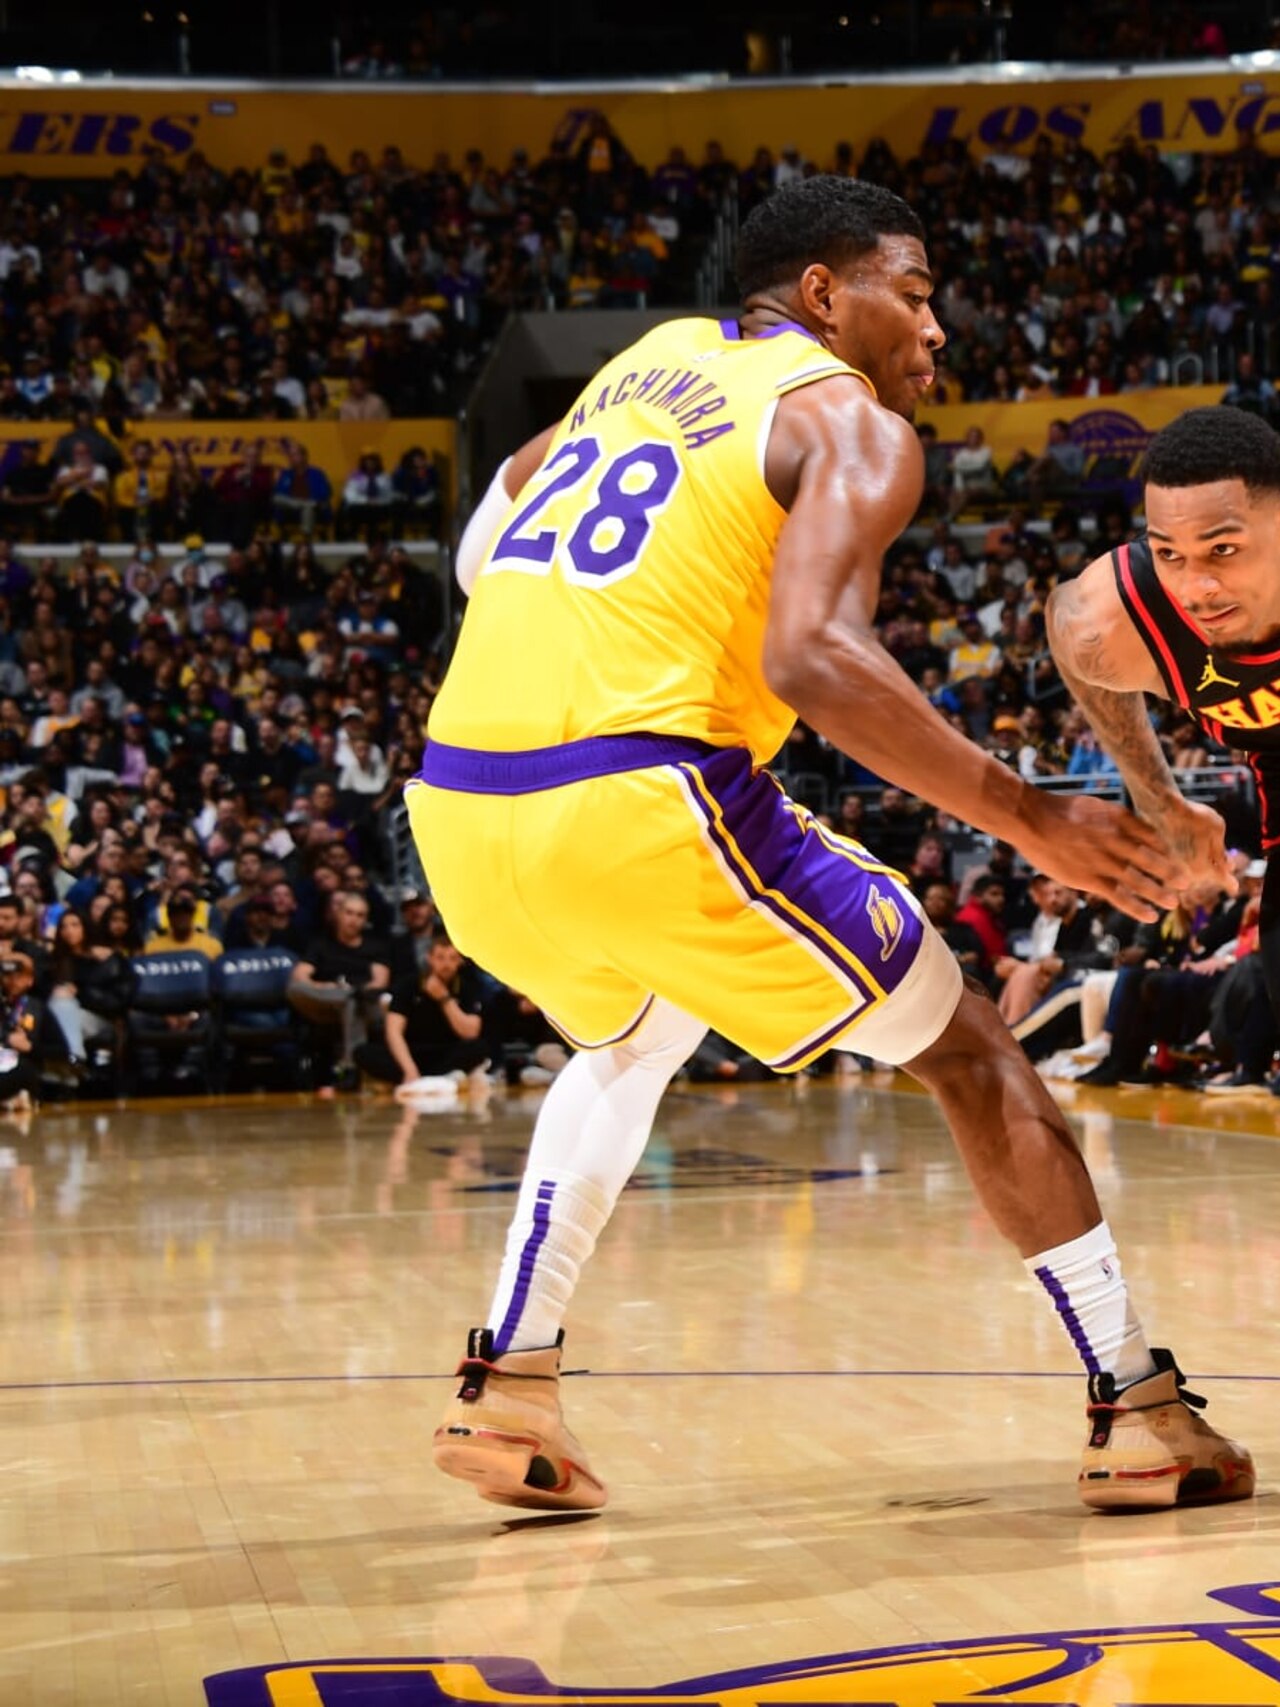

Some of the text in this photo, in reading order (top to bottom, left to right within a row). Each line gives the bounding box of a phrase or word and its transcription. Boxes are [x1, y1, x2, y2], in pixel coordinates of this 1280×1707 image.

[922, 103, 1092, 147] LOS
[569, 368, 736, 450] HACHIMURA
[487, 434, 681, 580] 28
